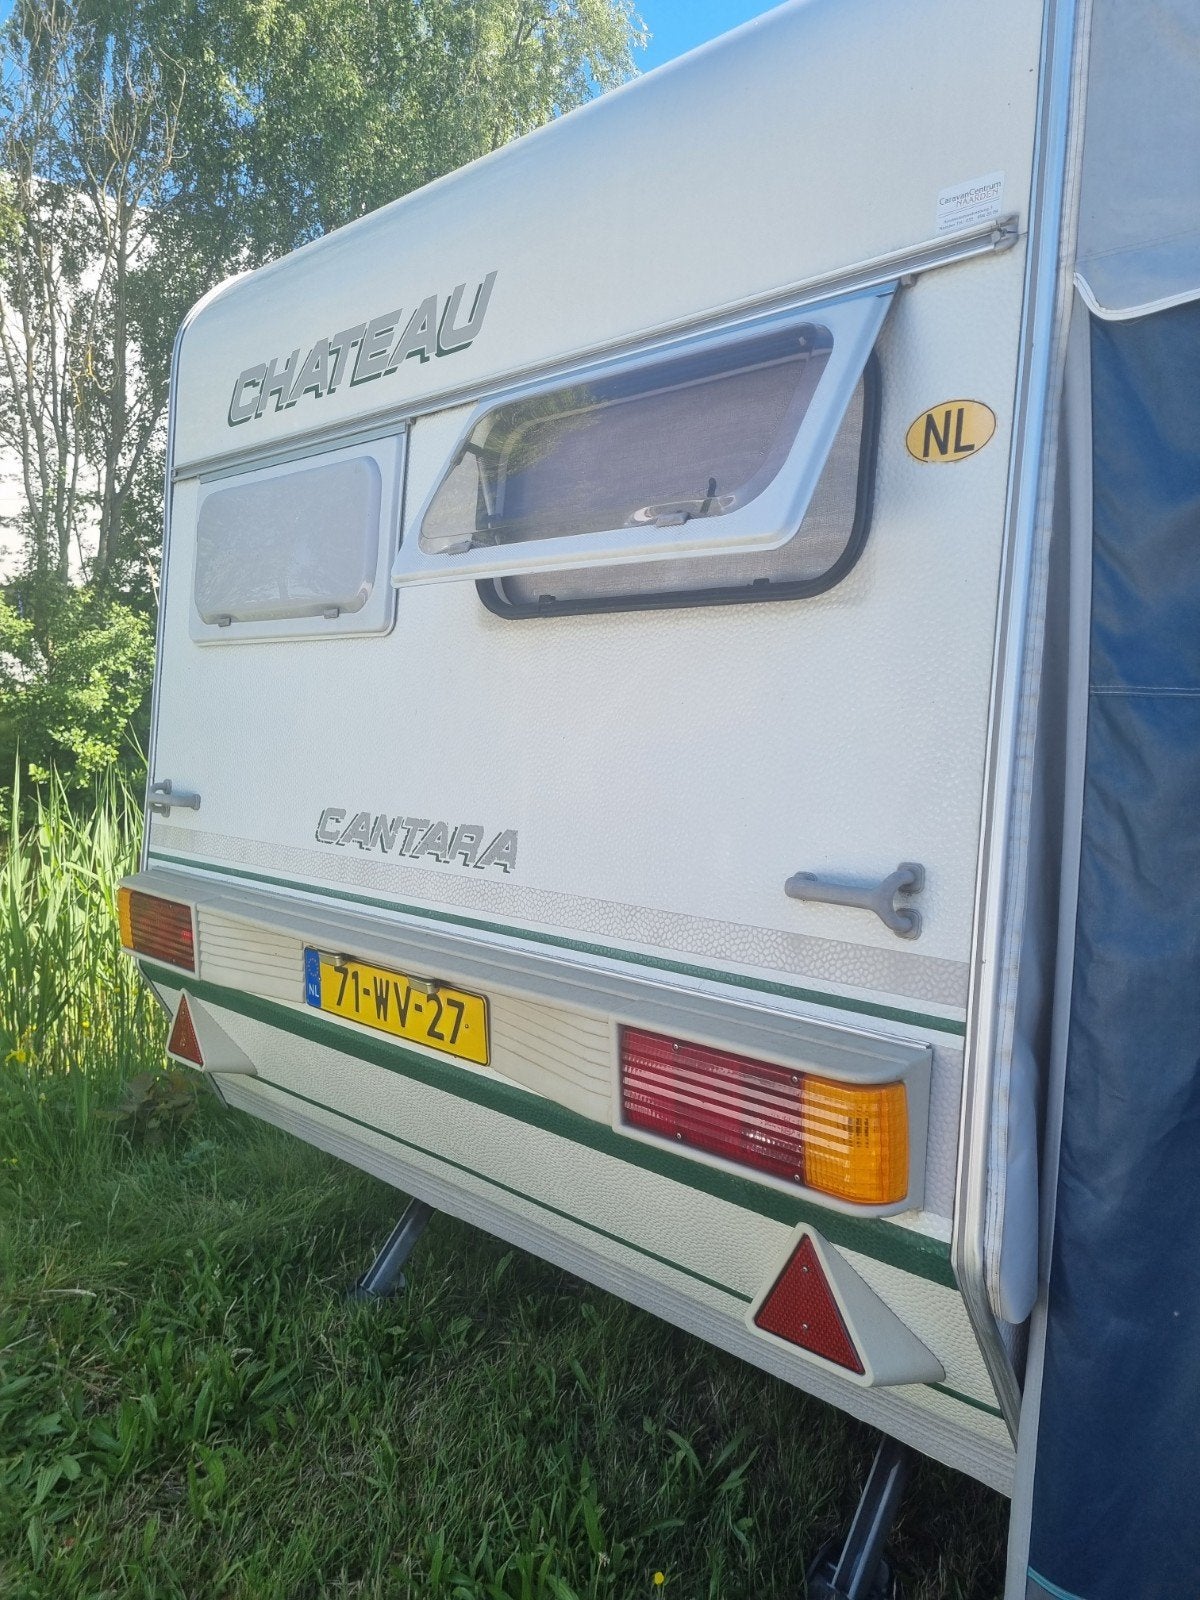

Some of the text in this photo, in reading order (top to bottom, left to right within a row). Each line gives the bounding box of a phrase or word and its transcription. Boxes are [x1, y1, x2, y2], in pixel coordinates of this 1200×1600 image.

[939, 181, 1001, 205] CaravanCentrum
[227, 270, 498, 427] CHATEAU
[923, 407, 975, 458] NL
[315, 807, 518, 873] CANTARA
[309, 983, 319, 997] NL
[334, 965, 465, 1044] 71-WV-27
